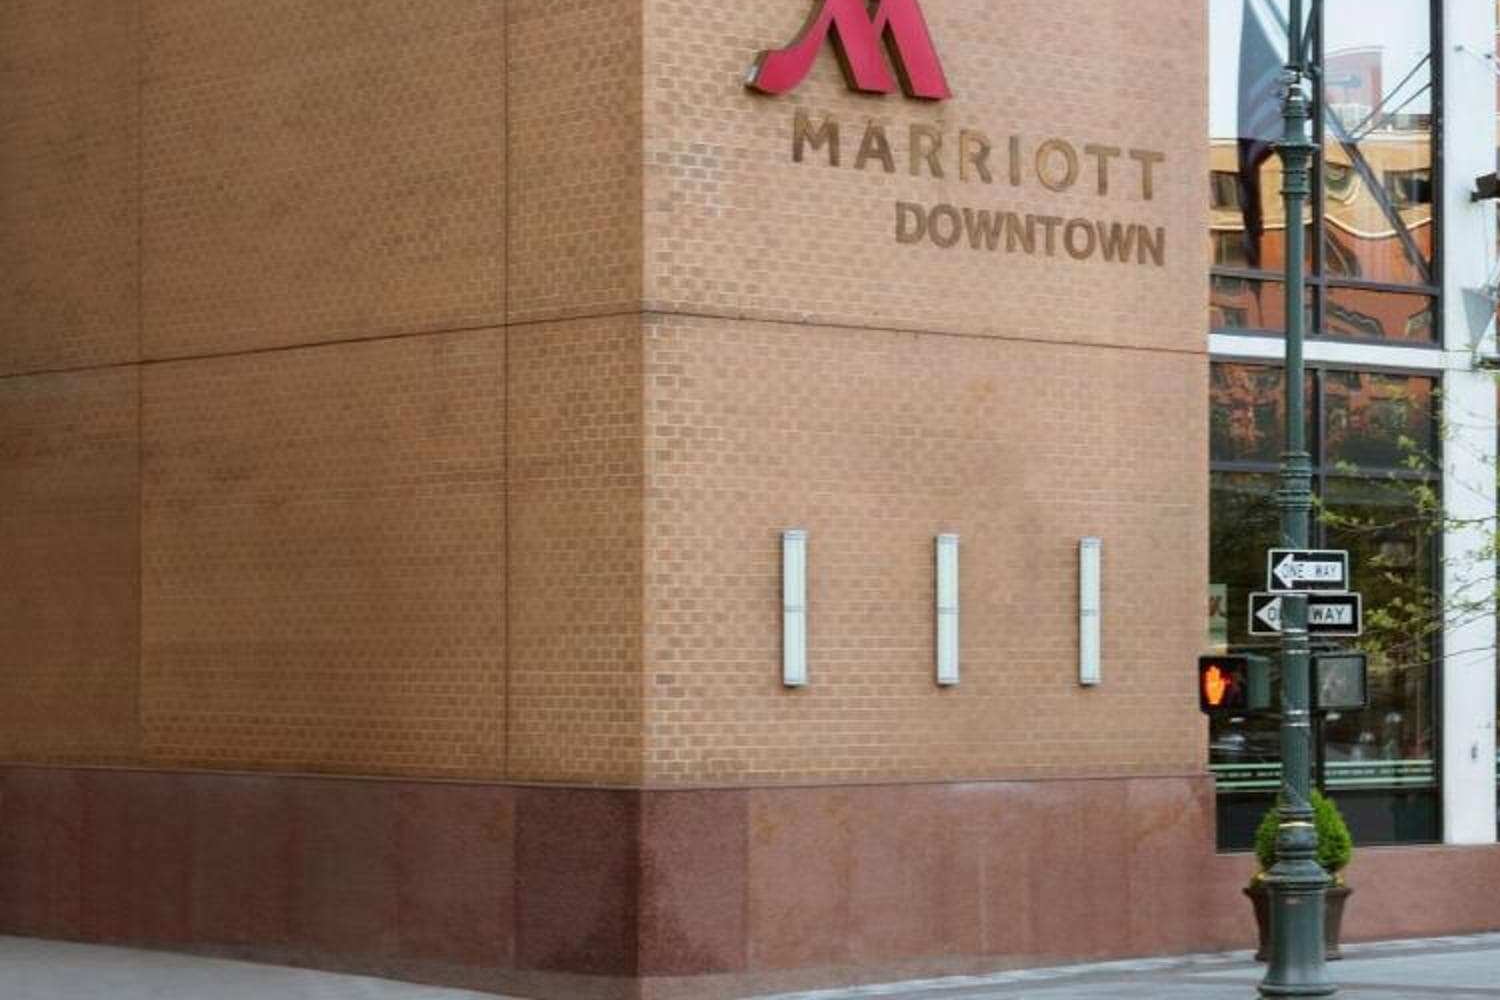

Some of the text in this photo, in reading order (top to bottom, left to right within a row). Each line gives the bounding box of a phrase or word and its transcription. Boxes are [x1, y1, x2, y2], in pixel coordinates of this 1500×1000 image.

[792, 109, 1165, 201] MARRIOTT
[896, 202, 1165, 266] DOWNTOWN
[1281, 563, 1338, 579] ONE WAY
[1311, 607, 1345, 621] WAY
